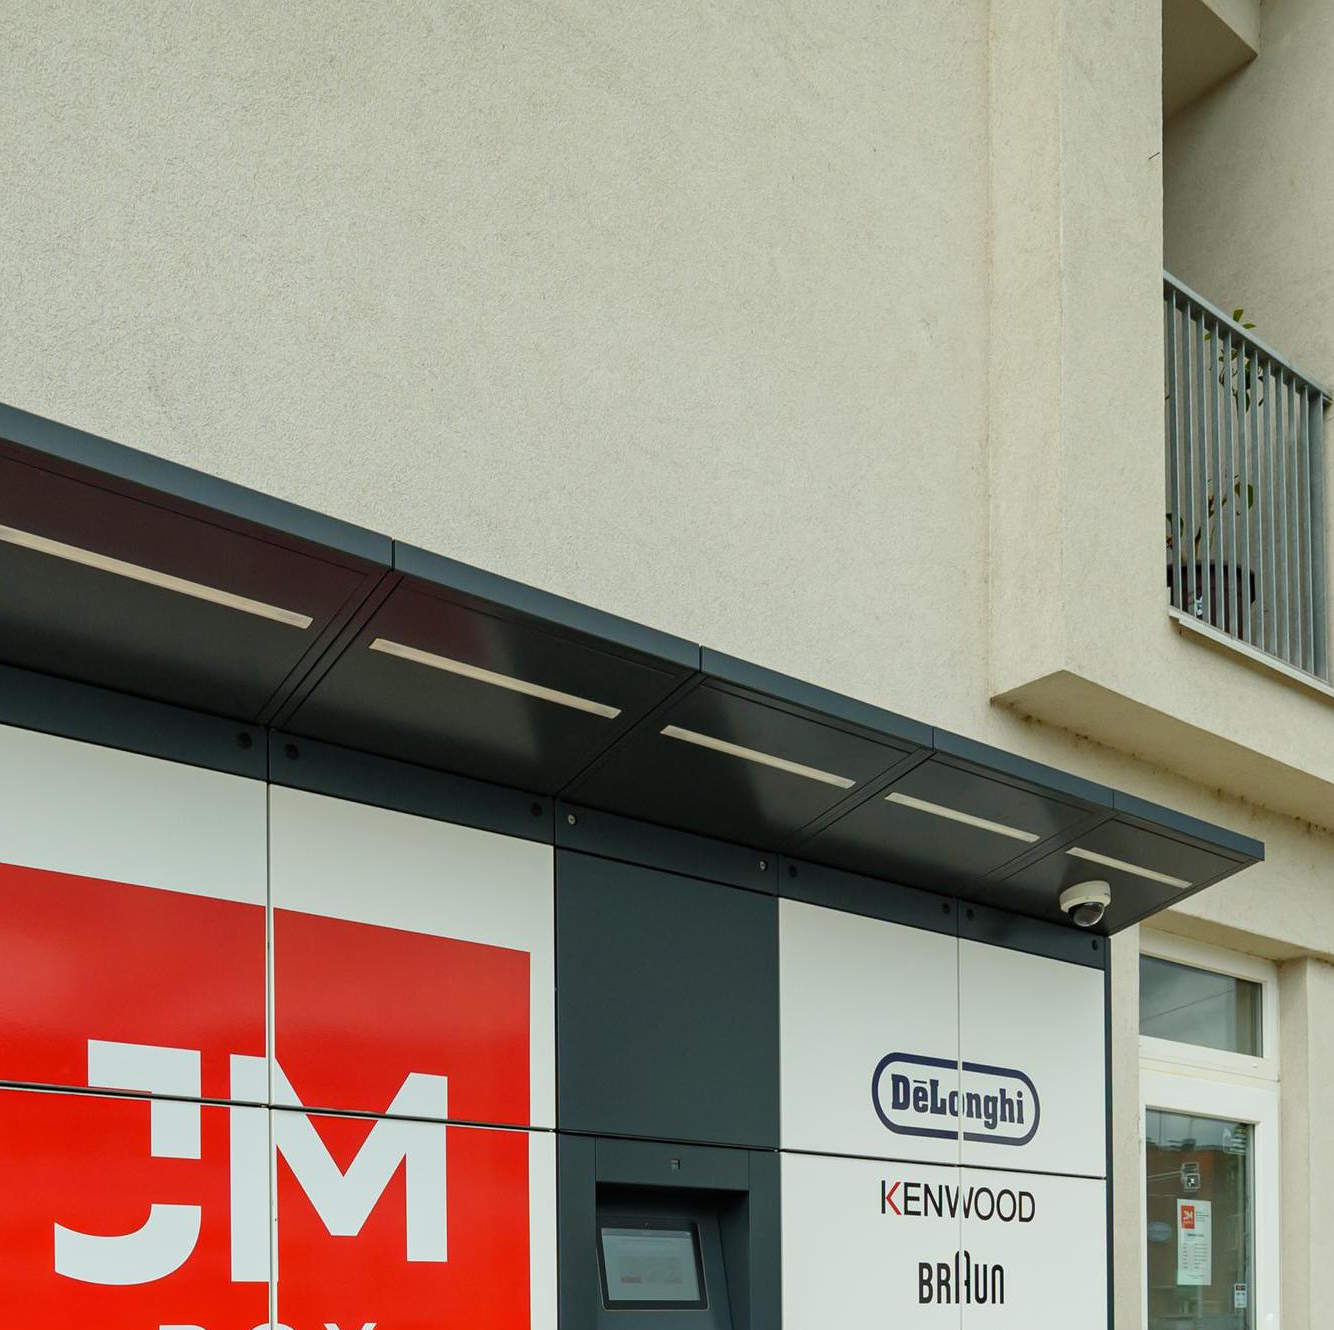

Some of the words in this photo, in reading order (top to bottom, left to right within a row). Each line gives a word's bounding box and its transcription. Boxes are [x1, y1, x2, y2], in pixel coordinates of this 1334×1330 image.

[54, 1039, 448, 1285] JM
[880, 1180, 1036, 1223] KENWOOD
[918, 1249, 1005, 1304] BRAUN
